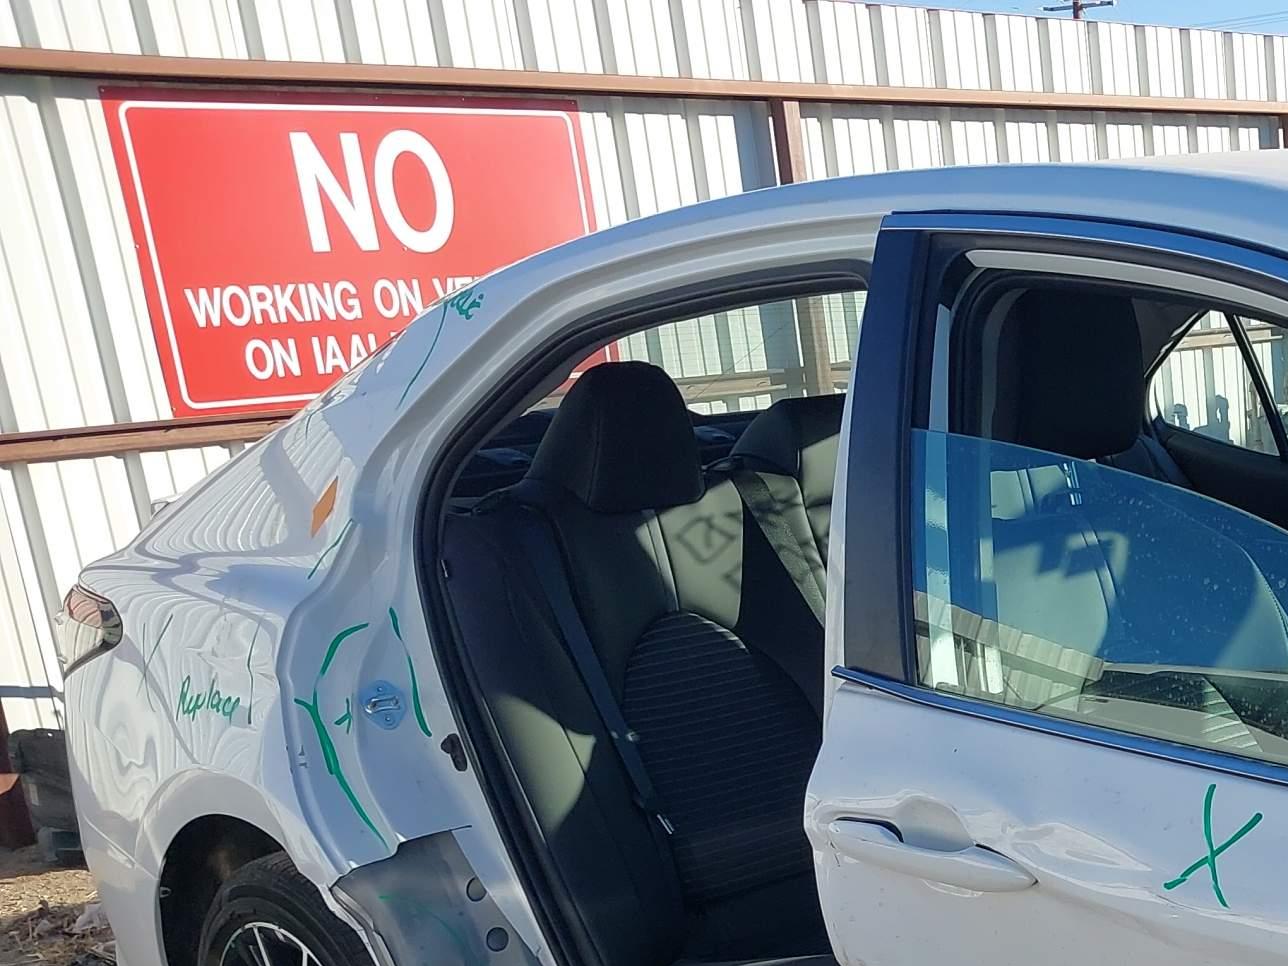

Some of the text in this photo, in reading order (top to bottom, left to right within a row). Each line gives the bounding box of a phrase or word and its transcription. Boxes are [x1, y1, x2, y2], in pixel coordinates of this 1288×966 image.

[288, 128, 456, 254] NO
[184, 279, 364, 328] WORKING
[372, 277, 423, 318] ON
[244, 336, 302, 380] ON
[175, 674, 241, 725] Replace
